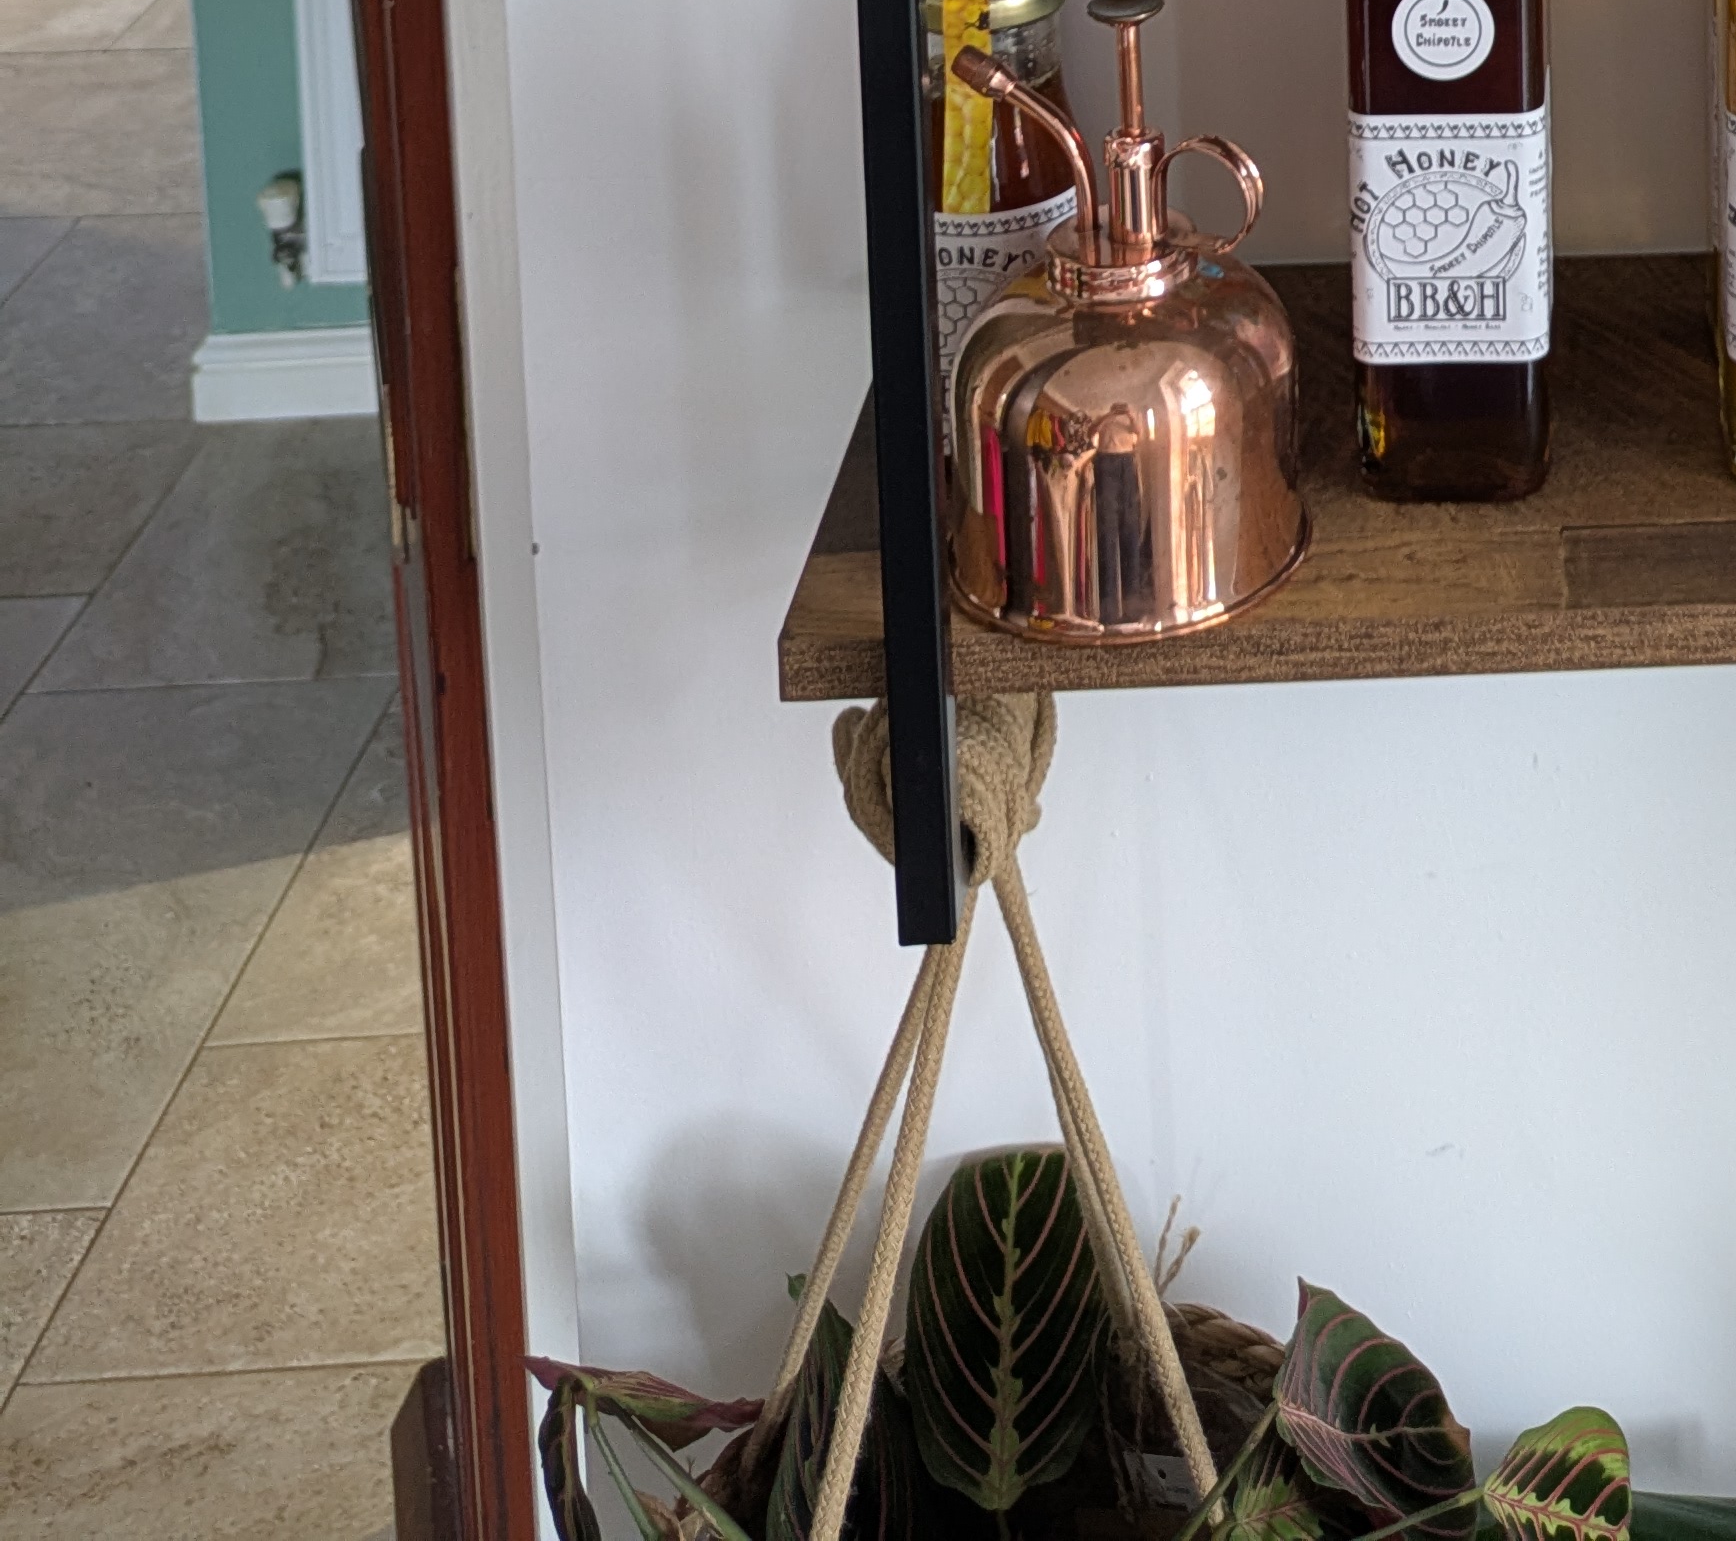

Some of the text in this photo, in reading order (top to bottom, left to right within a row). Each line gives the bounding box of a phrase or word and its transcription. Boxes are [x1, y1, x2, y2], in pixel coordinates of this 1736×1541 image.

[1419, 14, 1468, 28] SMOKEY
[1415, 32, 1472, 47] CHIPOTLE
[1351, 147, 1502, 233] HOT HONEY
[938, 245, 1020, 272] ONEY
[1392, 279, 1502, 319] BB&H
